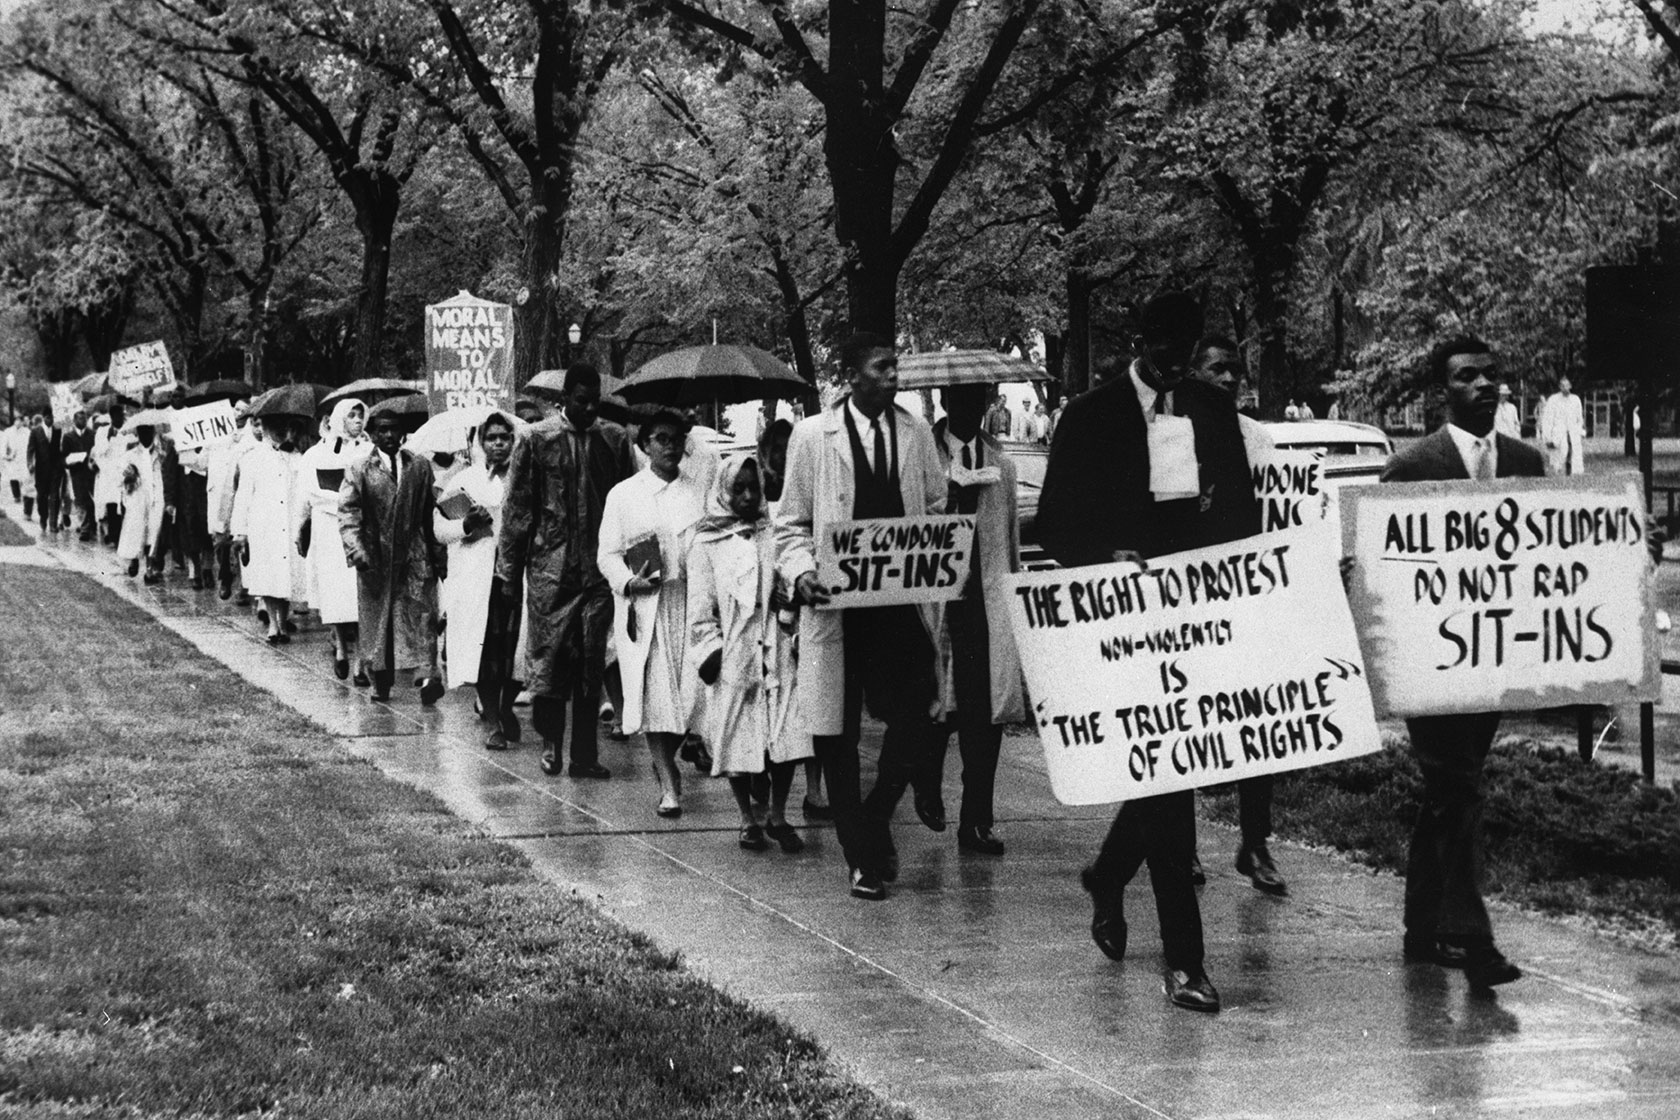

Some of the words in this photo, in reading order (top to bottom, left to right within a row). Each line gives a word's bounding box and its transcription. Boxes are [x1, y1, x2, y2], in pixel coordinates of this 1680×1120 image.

[432, 326, 505, 349] MEANS
[457, 348, 484, 368] TO
[433, 368, 501, 391] MORAL
[182, 414, 235, 446] SIT-INS
[832, 527, 865, 555] WE
[1385, 512, 1435, 553] ALL
[1444, 510, 1490, 553] BIG
[1494, 497, 1520, 561] 8
[1525, 506, 1642, 551] STUDENTS
[831, 551, 964, 595] SIT-INS
[1016, 583, 1070, 629] THE
[1069, 571, 1147, 624] RIGHT
[1148, 567, 1183, 609] TO
[1185, 545, 1291, 605] PROTEST
[1414, 566, 1447, 605] DO
[1458, 563, 1519, 603] NOT
[1533, 561, 1589, 598] RAP
[1100, 618, 1233, 662] NON-VIOLENTLY
[1435, 603, 1614, 671] SIT-INS
[1160, 657, 1189, 695] IS
[1115, 698, 1193, 741] TRUE
[1199, 656, 1362, 728] PRINCIPLE"
[1128, 739, 1163, 783] OF
[1171, 731, 1235, 776] CIVIL
[1239, 709, 1344, 764] RIGHTS
